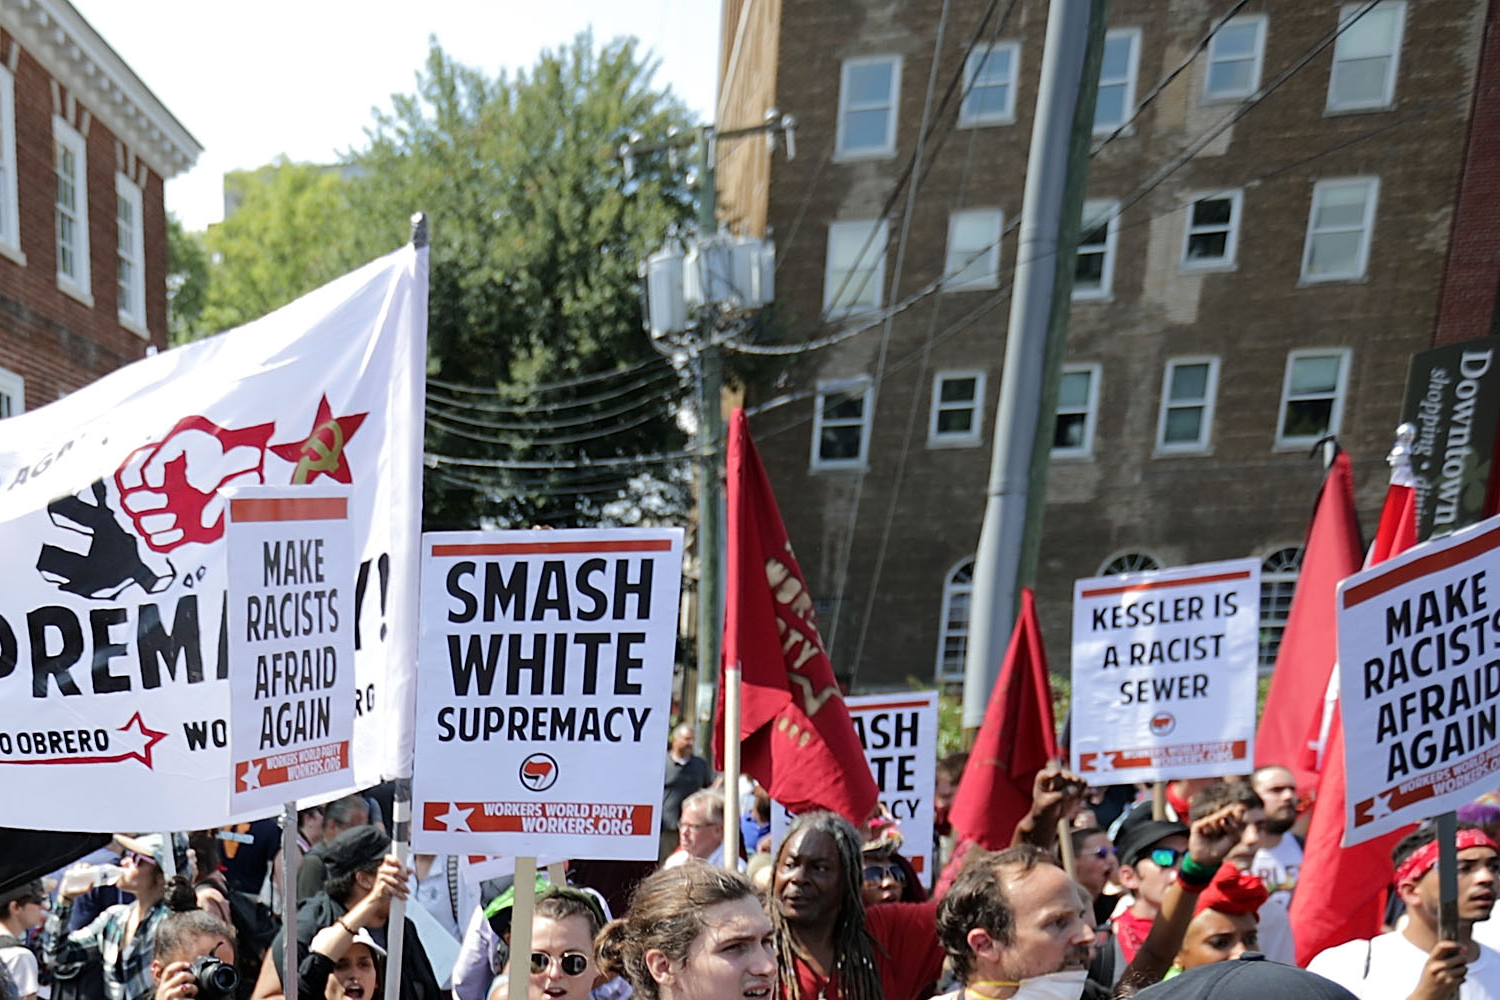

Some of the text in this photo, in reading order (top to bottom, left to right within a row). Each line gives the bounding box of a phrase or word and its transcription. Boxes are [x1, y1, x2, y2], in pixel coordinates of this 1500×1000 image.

[1412, 367, 1451, 456] shopping
[1434, 349, 1493, 525] Downtown
[263, 538, 325, 587] MAKE
[247, 588, 339, 642] RACISTS
[446, 558, 654, 623] SMASH
[1092, 591, 1238, 631] KESSLER IS
[1386, 570, 1487, 645] MAKE
[255, 646, 337, 700] AFRAID
[448, 632, 646, 696] WHITE
[1103, 634, 1225, 669] A RACIST
[1120, 674, 1209, 705] SEWER
[1377, 659, 1500, 744] AFRAID
[17, 729, 109, 755] OBRERO
[260, 696, 331, 750] AGAIN
[437, 706, 651, 742] SUPREMACY
[1387, 704, 1497, 782] AGAIN
[483, 803, 634, 819] WORKERS WORLD PARTY
[521, 817, 633, 836] WORKERS.ORG
